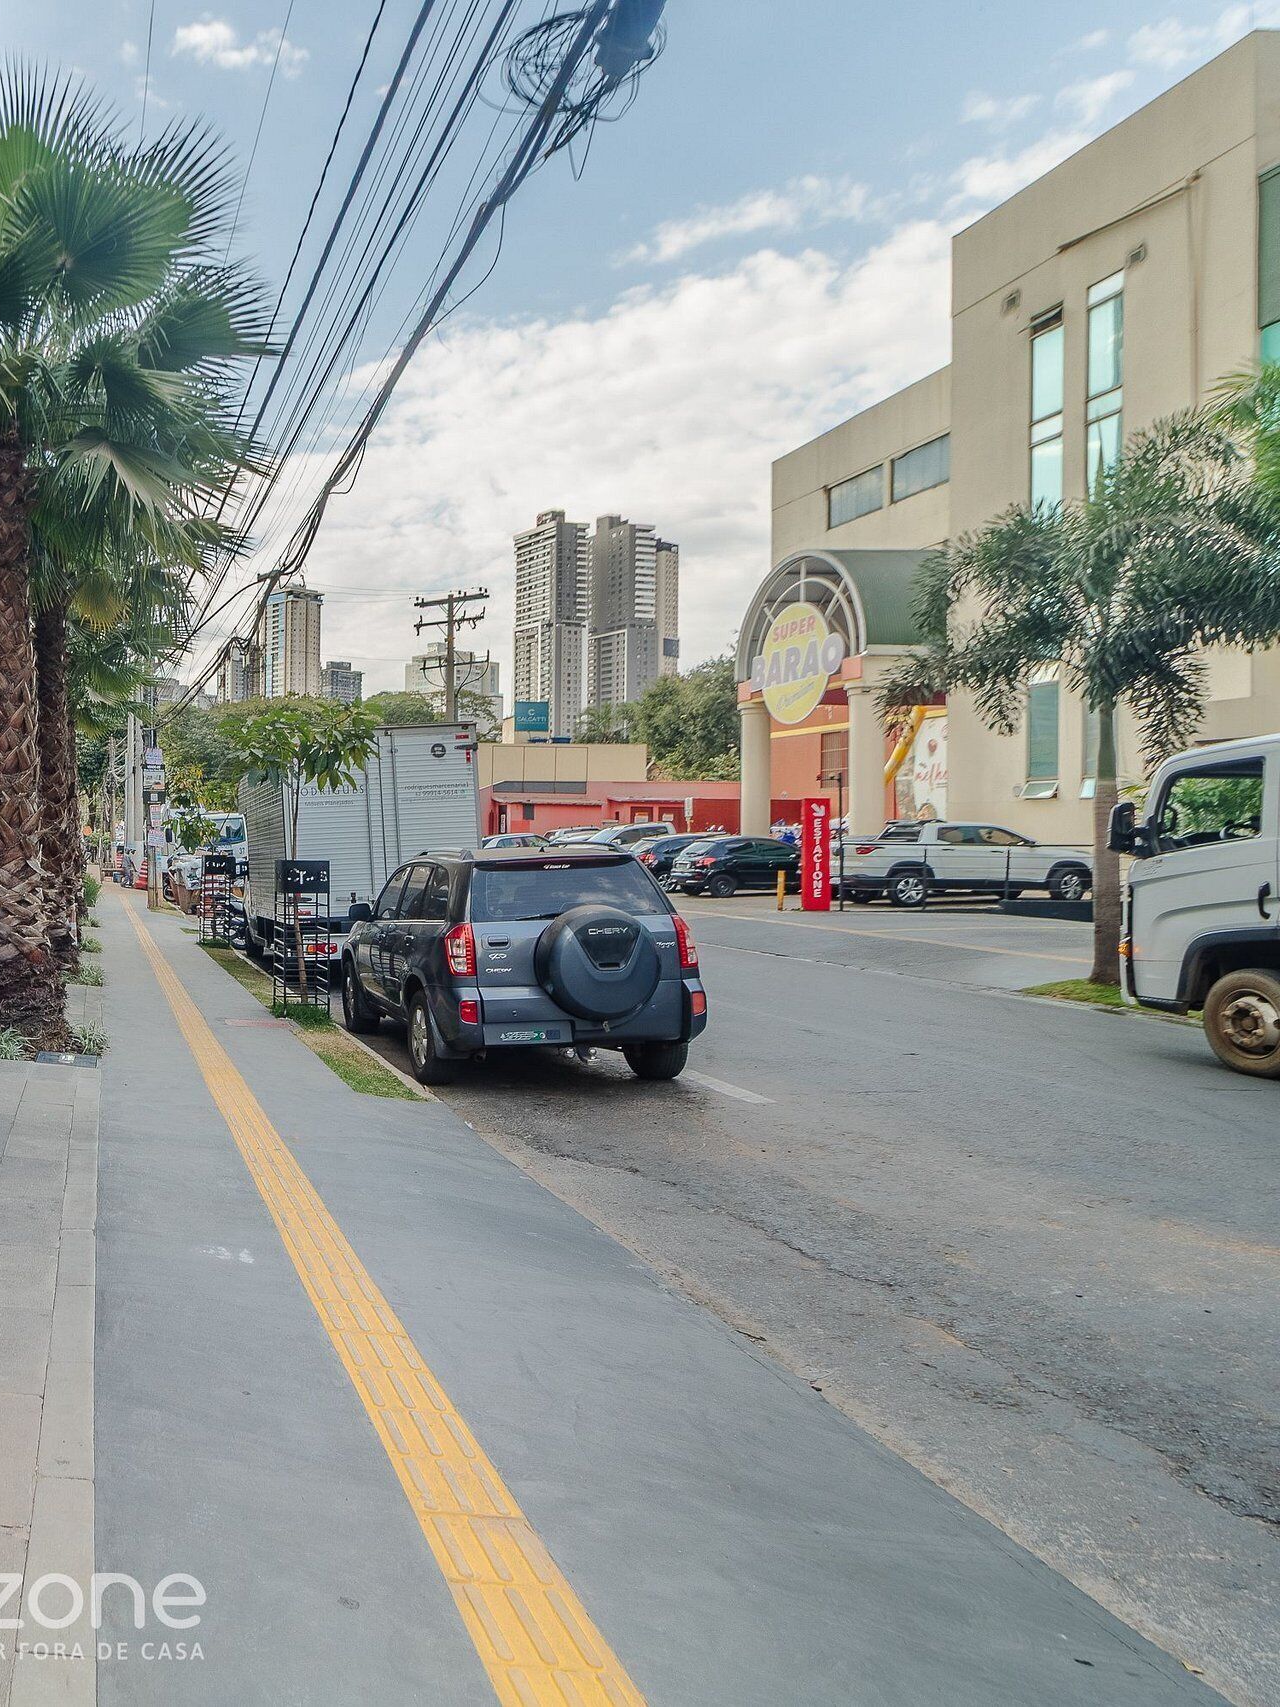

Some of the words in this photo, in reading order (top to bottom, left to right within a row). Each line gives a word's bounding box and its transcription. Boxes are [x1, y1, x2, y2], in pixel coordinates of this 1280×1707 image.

[772, 614, 817, 643] SUPER
[812, 818, 824, 898] ESTACIONE
[588, 926, 629, 936] CHERY
